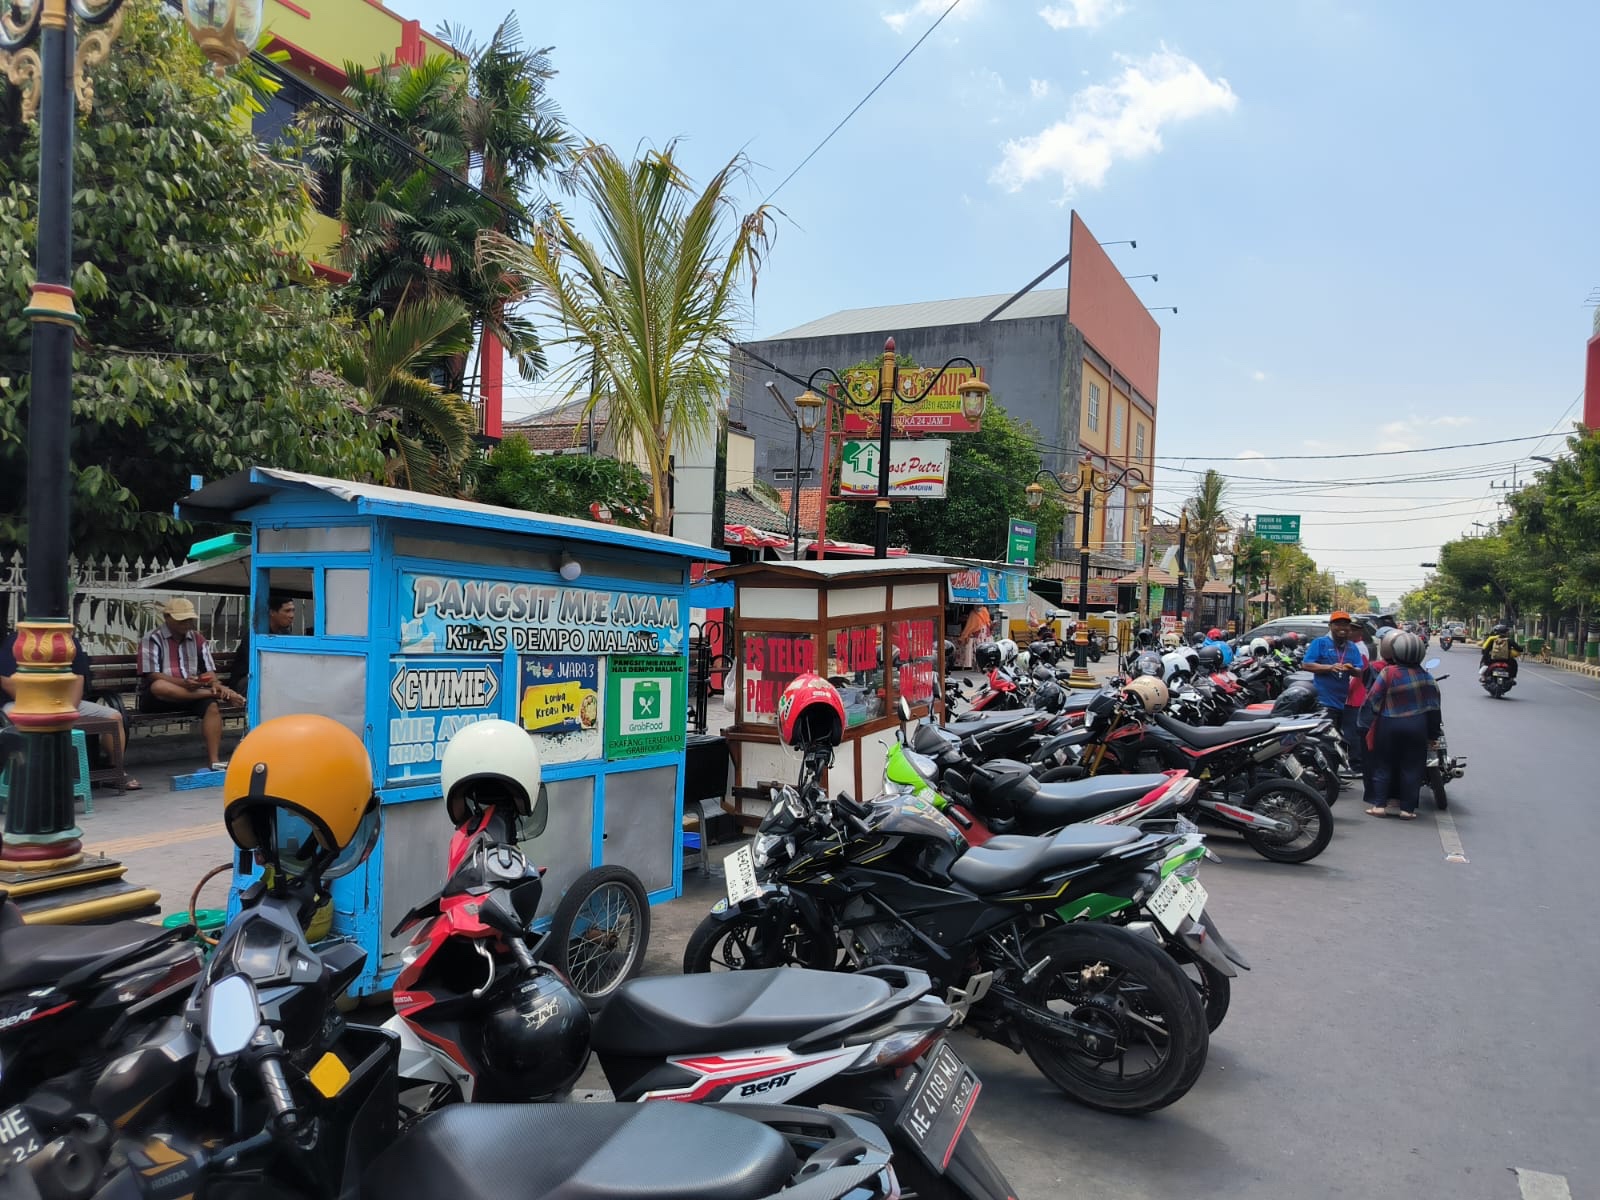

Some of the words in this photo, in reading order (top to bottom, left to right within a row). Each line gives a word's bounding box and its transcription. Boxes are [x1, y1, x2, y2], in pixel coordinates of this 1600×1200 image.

[916, 417, 925, 425] 24
[927, 417, 943, 425] JAM
[908, 457, 943, 473] Putri
[414, 577, 557, 622] PANGSIT
[558, 590, 611, 626] MIE
[612, 593, 680, 629] AYAM
[446, 624, 507, 651] KHAS
[512, 627, 584, 652] DEMPO
[588, 629, 659, 652] MALANG
[557, 661, 587, 678] JUARA
[589, 663, 595, 678] 3
[746, 636, 765, 671] ES
[767, 637, 814, 673] TELER
[404, 668, 487, 712] CWIMIE
[746, 678, 775, 714] PAK
[389, 716, 435, 745] MIE
[437, 712, 499, 742] AY
[629, 721, 663, 732] GrabFood
[388, 742, 435, 766] KHAS
[910, 1108, 931, 1140] AE
[922, 1073, 948, 1115] 4109
[938, 1053, 959, 1082] MJ
